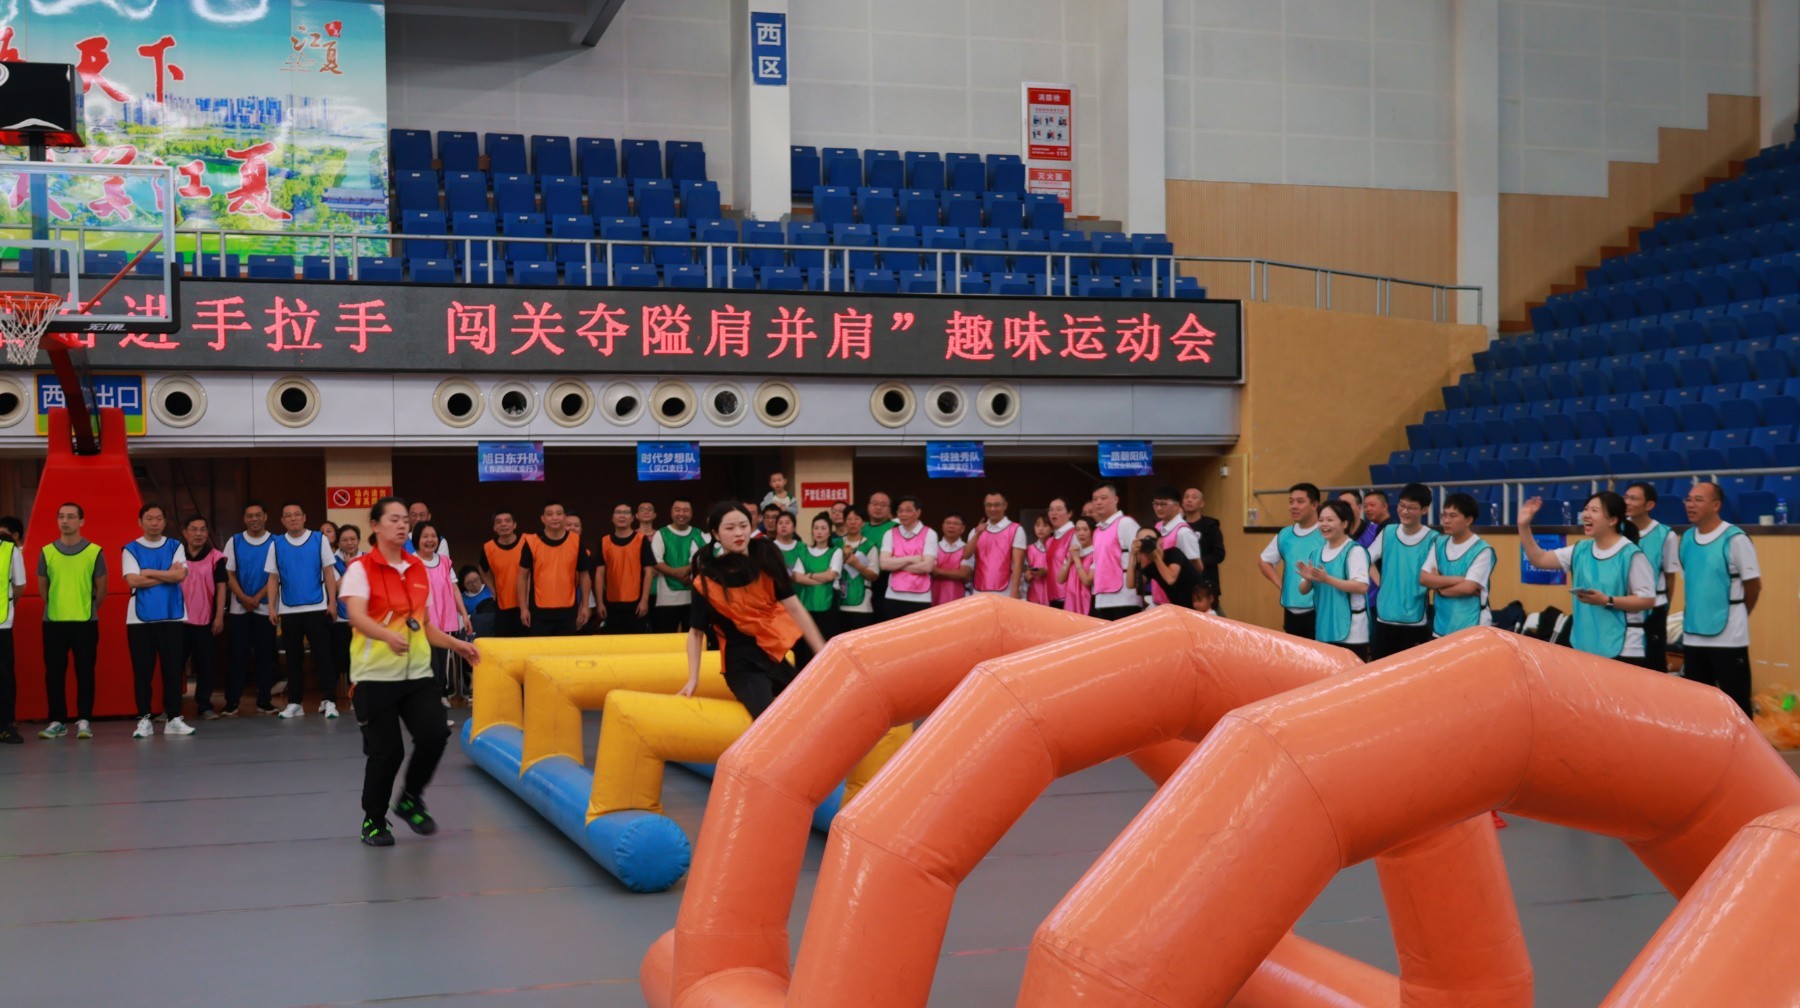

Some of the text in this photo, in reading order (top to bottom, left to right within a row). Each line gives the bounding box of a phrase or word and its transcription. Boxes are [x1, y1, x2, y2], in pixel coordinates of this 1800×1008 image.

[755, 22, 782, 78] 西区
[1037, 172, 1063, 181] 灭火器
[41, 384, 139, 409] 西出口
[482, 452, 540, 464] 旭日东升队
[641, 452, 697, 464] 时代梦想队
[930, 451, 980, 462] 一枝独秀队
